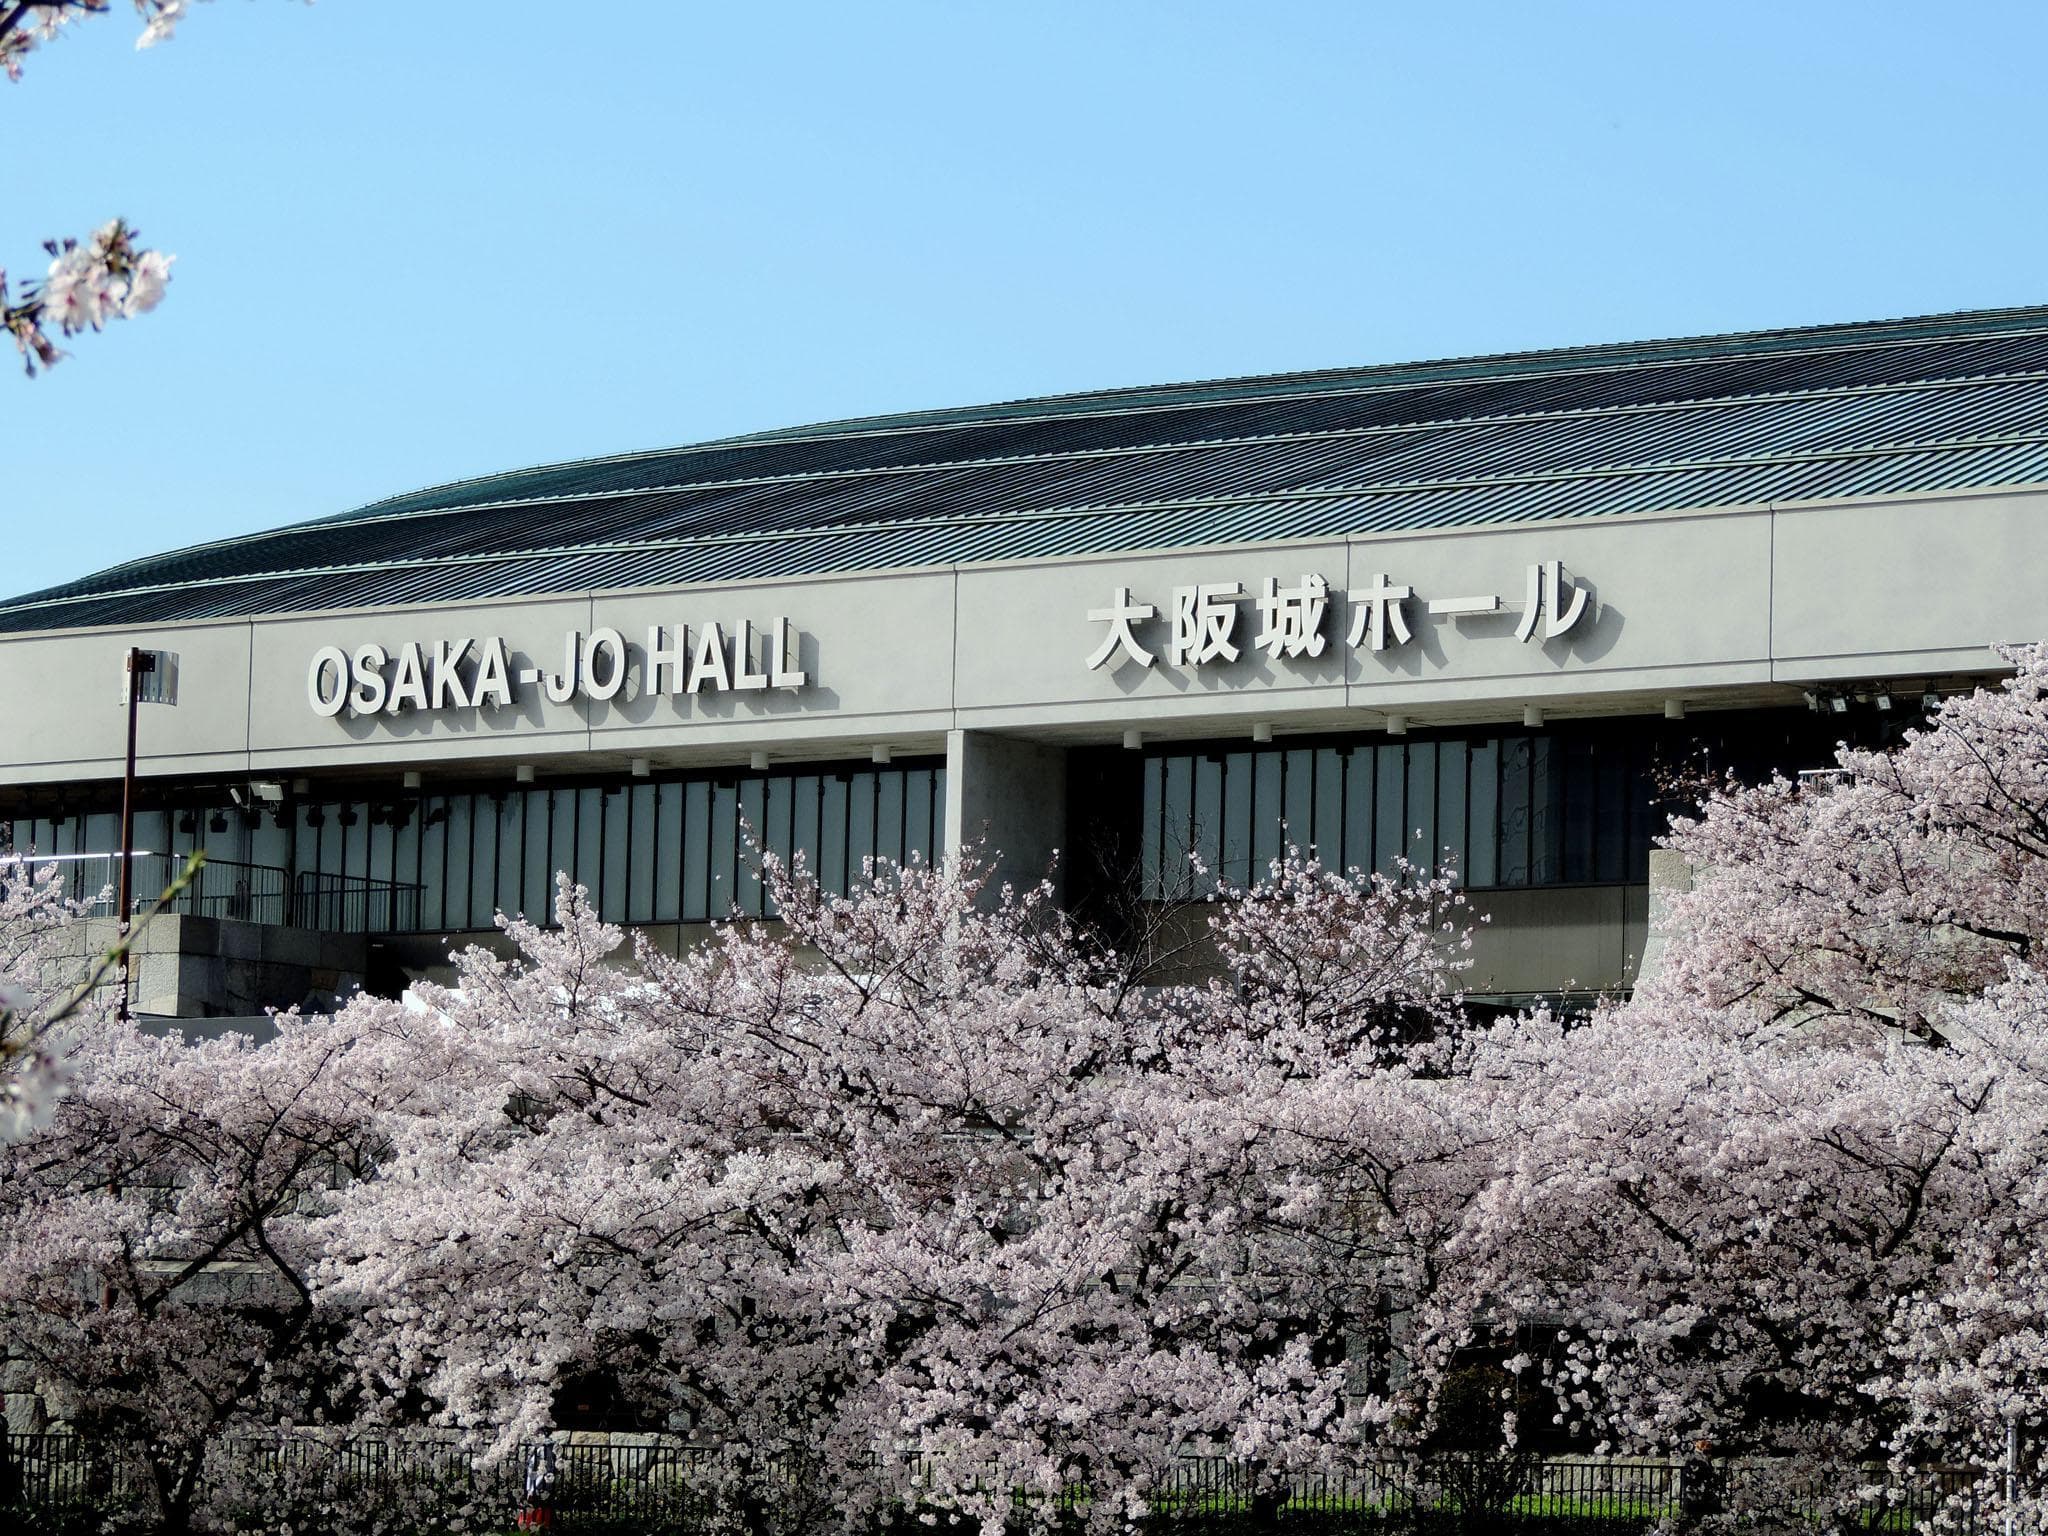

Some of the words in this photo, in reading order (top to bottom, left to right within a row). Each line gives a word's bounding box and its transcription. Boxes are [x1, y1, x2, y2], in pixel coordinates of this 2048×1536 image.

[308, 627, 629, 717] OSAKA-JO
[646, 616, 809, 695] HALL
[1085, 560, 1591, 671] 大阪城ホール
